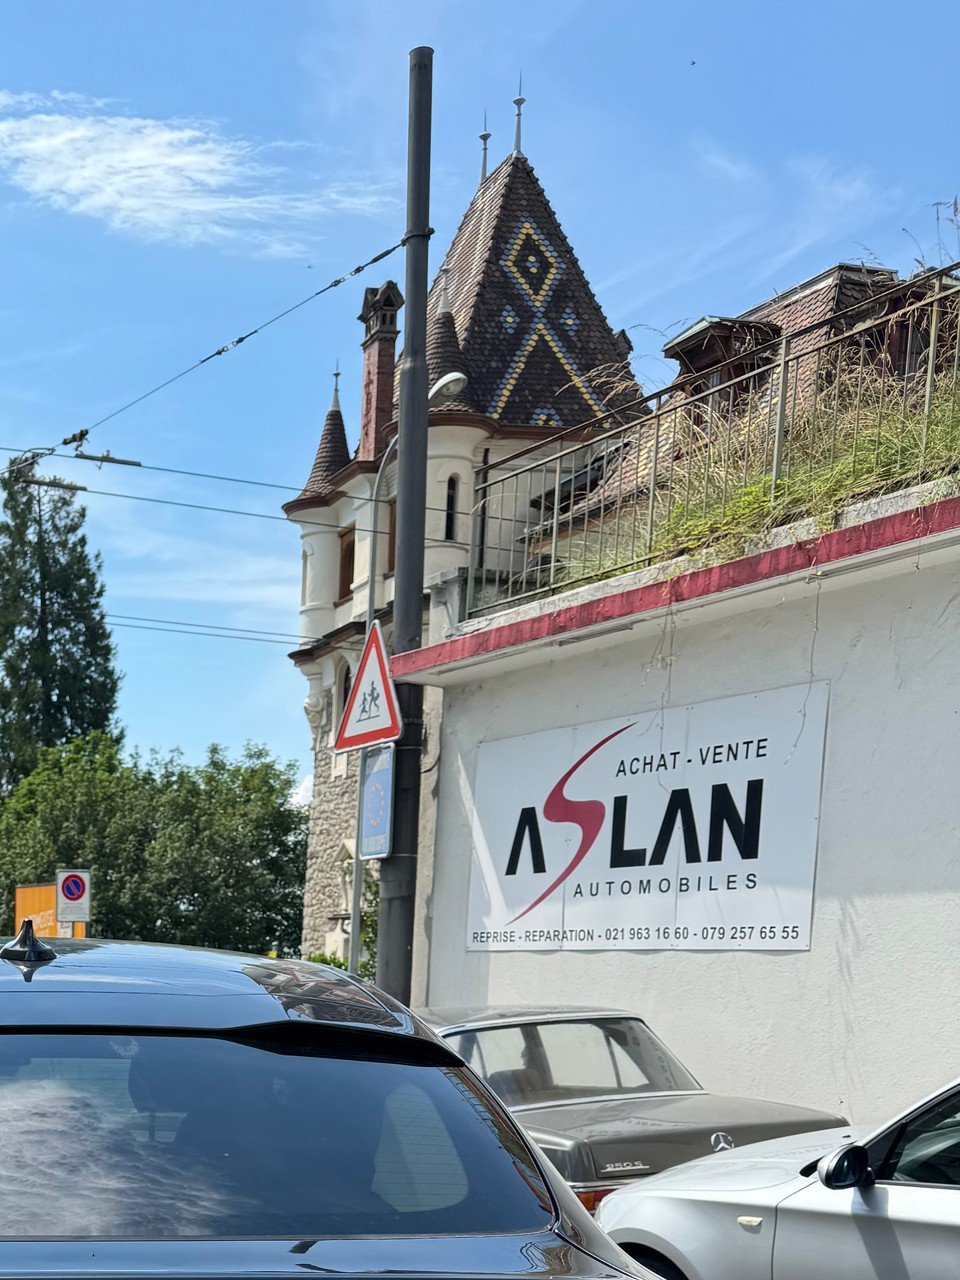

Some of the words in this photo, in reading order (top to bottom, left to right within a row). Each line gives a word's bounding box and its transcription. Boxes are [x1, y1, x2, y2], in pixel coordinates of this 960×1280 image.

[615, 751, 682, 777] ACHAT
[699, 737, 770, 765] VENTE
[504, 720, 764, 926] ASLAN
[573, 872, 759, 898] AUTOMOBILES
[472, 931, 515, 943] REPRISE
[524, 929, 594, 942] REPARATION
[605, 928, 625, 941] 021
[628, 927, 651, 940] 963
[655, 927, 671, 940] 16
[674, 927, 689, 940] 60
[701, 926, 726, 940] 079
[730, 926, 755, 940] 257
[759, 926, 777, 939] 65
[781, 925, 800, 939] 55
